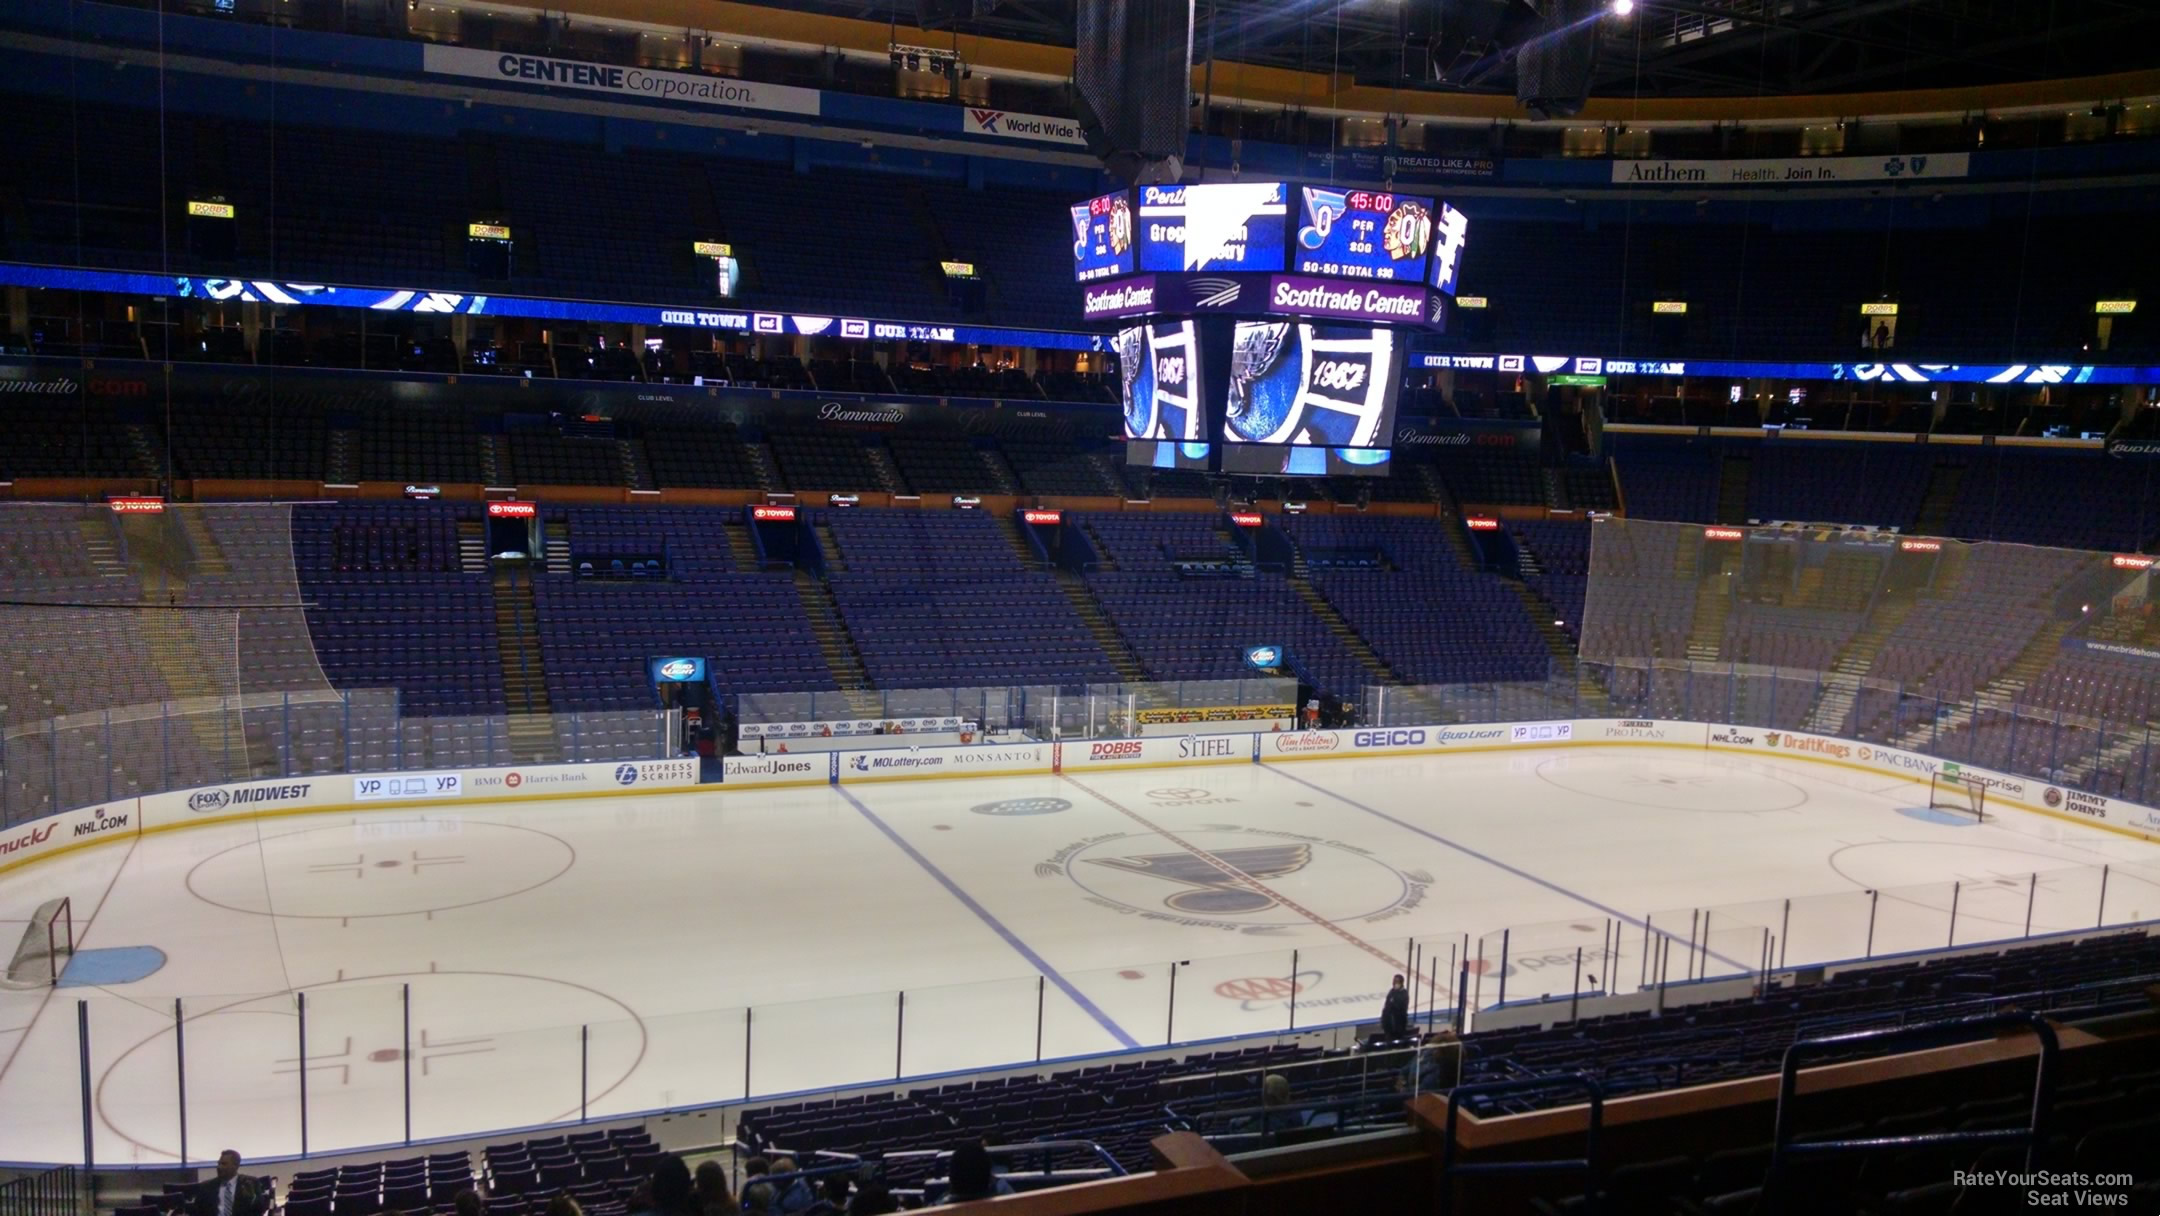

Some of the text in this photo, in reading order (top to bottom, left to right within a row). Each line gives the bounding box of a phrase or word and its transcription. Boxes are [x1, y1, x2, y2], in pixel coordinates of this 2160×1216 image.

[498, 54, 752, 102] CENTENE Corporation
[1006, 119, 1074, 137] World Wide
[1398, 156, 1440, 167] TREATED
[1442, 159, 1464, 168] LIKE
[1464, 160, 1472, 168] A
[1473, 160, 1494, 169] PRO
[1628, 162, 1836, 182] Anthem Health. Join In.
[195, 204, 228, 214] DOBBS
[1090, 197, 1111, 215] 45:00
[1350, 192, 1393, 212] 45:00
[1316, 205, 1332, 237] 0
[1352, 220, 1374, 231] PER
[475, 226, 505, 235] DOBBS
[1401, 214, 1417, 245] 0
[699, 244, 727, 252] DOBBS
[1349, 242, 1372, 253] SOG
[1303, 262, 1338, 275] 50-50
[1342, 265, 1373, 278] TOTAL
[1085, 288, 1124, 313] Scottrade
[1273, 282, 1362, 311] Scottrade
[661, 311, 747, 329] OUR TOWN
[875, 324, 906, 338] OUR
[1424, 355, 1494, 369] OUR TOWN
[1313, 359, 1366, 390] 1967
[817, 402, 904, 424] Bommarito
[1398, 427, 1470, 446] Bommarito
[125, 502, 163, 510] TOYOTA
[502, 504, 534, 514] TOYOTA
[766, 509, 794, 518] TOYOTA
[1035, 513, 1060, 521] TOYOTA
[1474, 519, 1498, 528] TOYOTA
[1913, 542, 1940, 550] TOYOTA
[2087, 641, 2160, 658] www.mcbridehom
[1442, 728, 1504, 740] BUD LIGHT
[1514, 727, 1527, 739] yp
[1557, 725, 1570, 737] yp
[1605, 728, 1665, 738] PRO PLAN
[1281, 734, 1298, 746] Tim
[1712, 734, 1754, 745] NHL.COM
[1783, 734, 1850, 758] DraftKings
[1091, 741, 1143, 755] DOBBS
[1179, 738, 1235, 758] STIFEL
[872, 755, 943, 769] MOLottery.com
[953, 752, 1032, 764] MONSANTO
[1874, 750, 1937, 774] PNC BANK
[641, 763, 692, 774] EXPRESS
[724, 759, 812, 776] Edward Jones
[436, 776, 457, 790] yp
[475, 772, 588, 787] BMO Harris Bank
[641, 771, 692, 781] SCRIPTS
[232, 784, 310, 804] MIDWEST
[360, 780, 381, 794] yp
[197, 791, 222, 805] FOX
[1153, 797, 1240, 808] TOYOTA
[2066, 790, 2107, 807] JIMMY
[2065, 800, 2106, 818] JOHN'S
[74, 814, 128, 837] NHL.COM
[1224, 978, 1291, 1001] AAA
